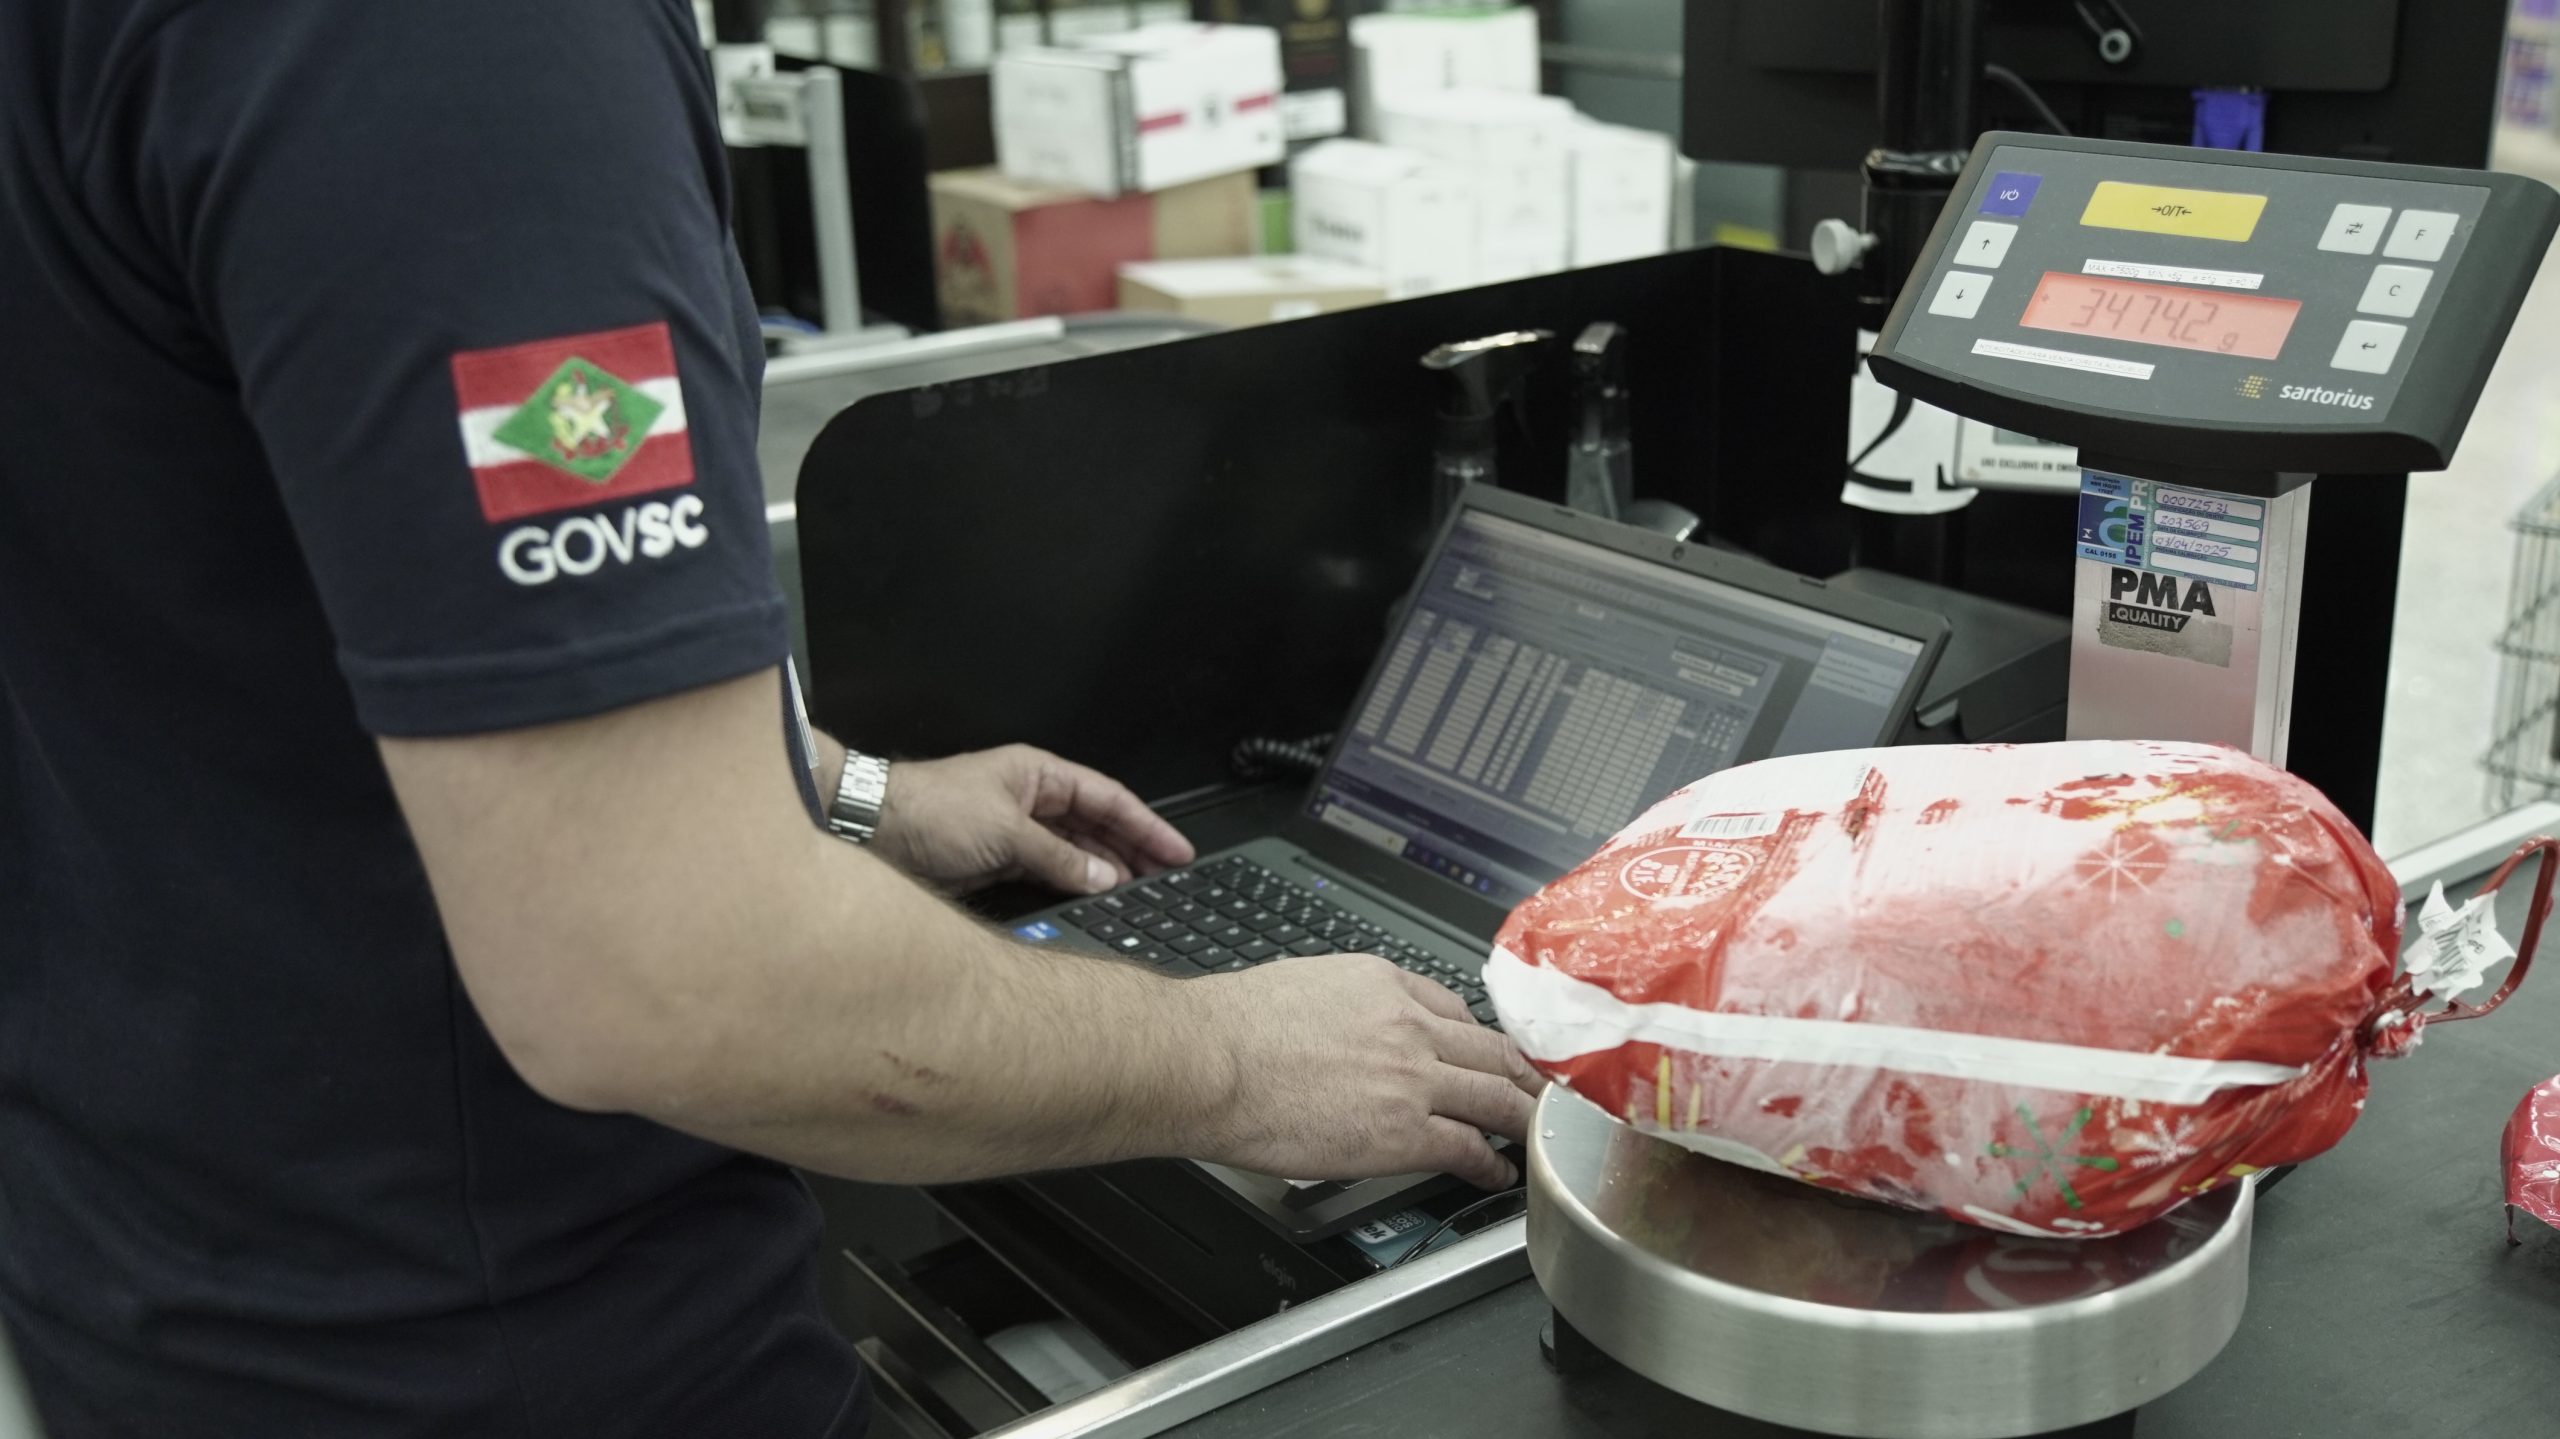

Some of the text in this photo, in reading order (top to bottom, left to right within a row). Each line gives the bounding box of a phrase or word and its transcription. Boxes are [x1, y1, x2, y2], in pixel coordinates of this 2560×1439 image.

[2415, 229, 2426, 241] F
[2389, 284, 2400, 297] C
[2279, 384, 2375, 411] sartorius
[2130, 480, 2149, 511] PR
[497, 494, 709, 586] GOVSC
[2124, 513, 2145, 566] IPEM
[2110, 567, 2217, 617] PMA
